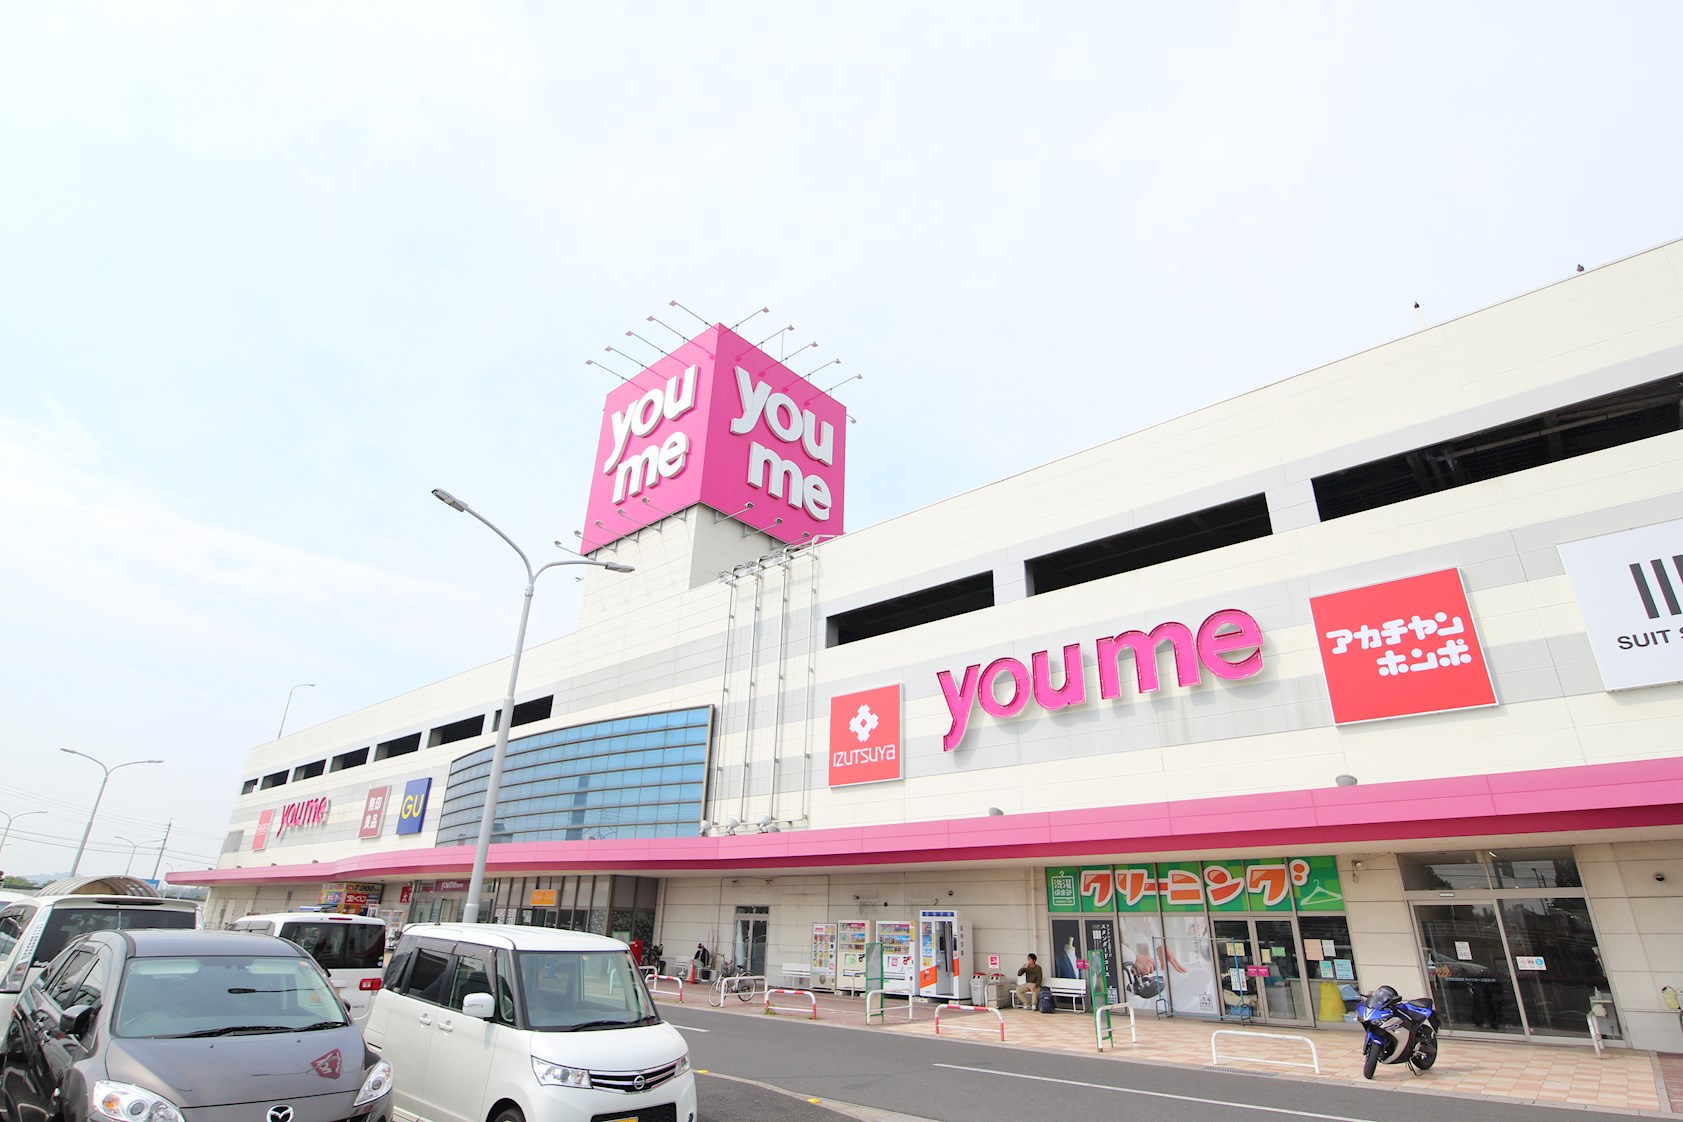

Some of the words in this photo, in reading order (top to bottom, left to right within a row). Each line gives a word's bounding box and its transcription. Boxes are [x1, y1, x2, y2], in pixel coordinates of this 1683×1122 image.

[604, 364, 698, 475] you
[730, 365, 834, 466] you
[612, 431, 689, 505] me
[748, 441, 832, 521] me
[1376, 638, 1472, 676] ホンポ
[1617, 629, 1670, 650] SUIT
[363, 814, 378, 830] 良品
[367, 796, 383, 811] 無印
[401, 793, 425, 819] GU
[345, 894, 368, 903] 宝くじ
[1081, 859, 1311, 907] クリーニング
[1101, 924, 1111, 977] スタンダードコース
